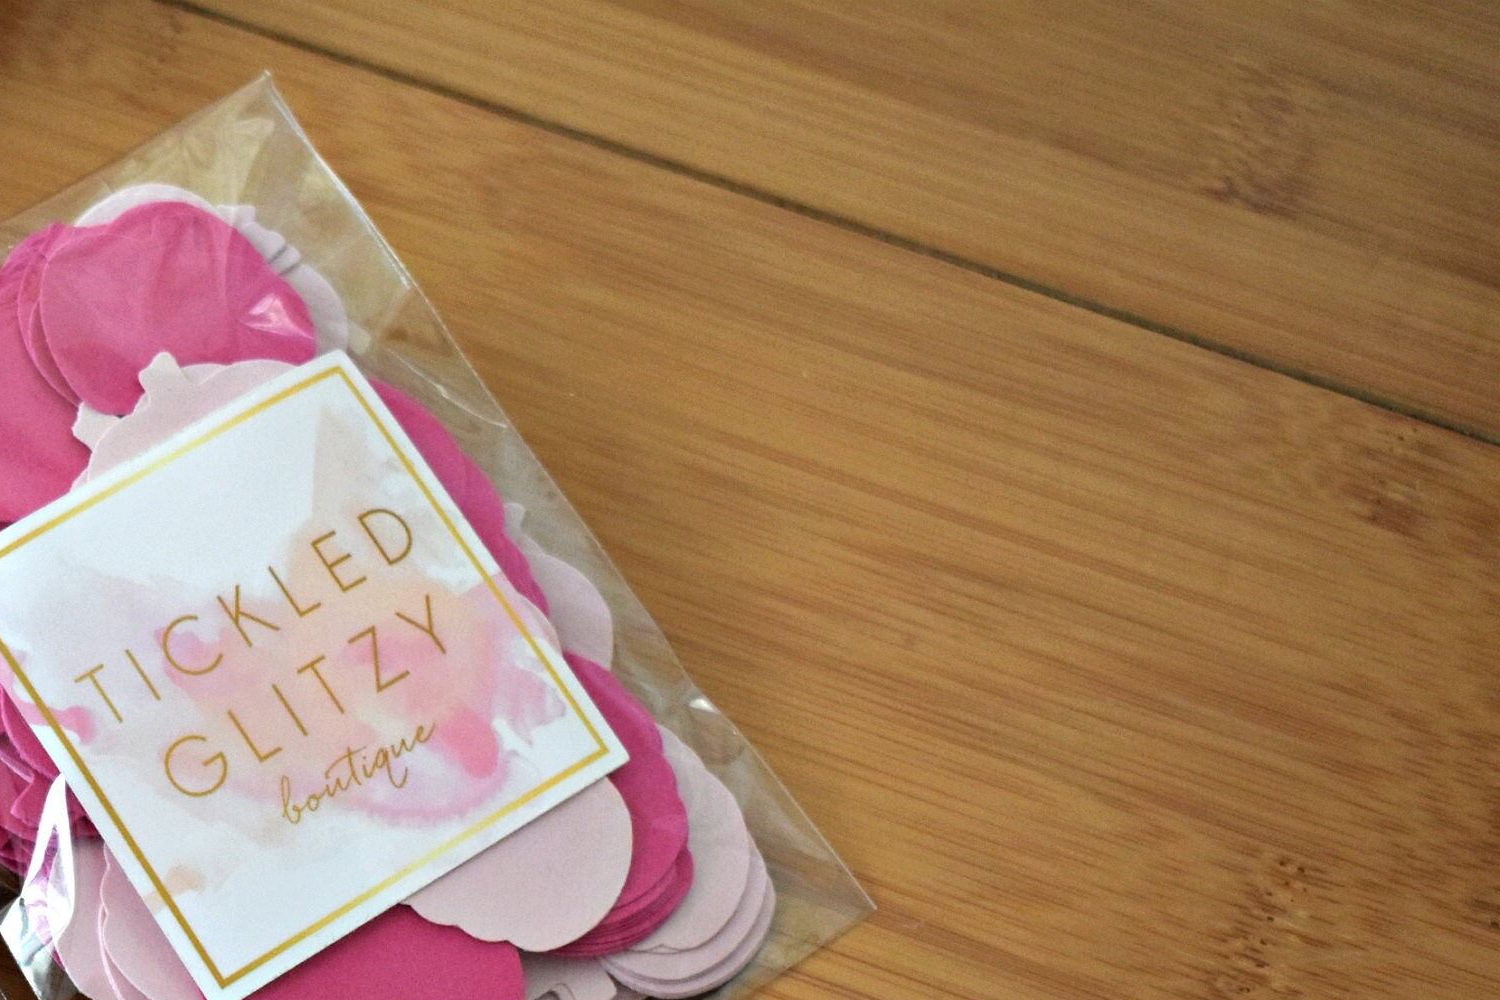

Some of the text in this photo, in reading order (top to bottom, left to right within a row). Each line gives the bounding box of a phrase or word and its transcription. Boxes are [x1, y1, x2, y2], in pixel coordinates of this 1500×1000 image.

[74, 507, 414, 724] TICKLED
[163, 593, 448, 797] GLITZY
[279, 721, 437, 825] boutique
